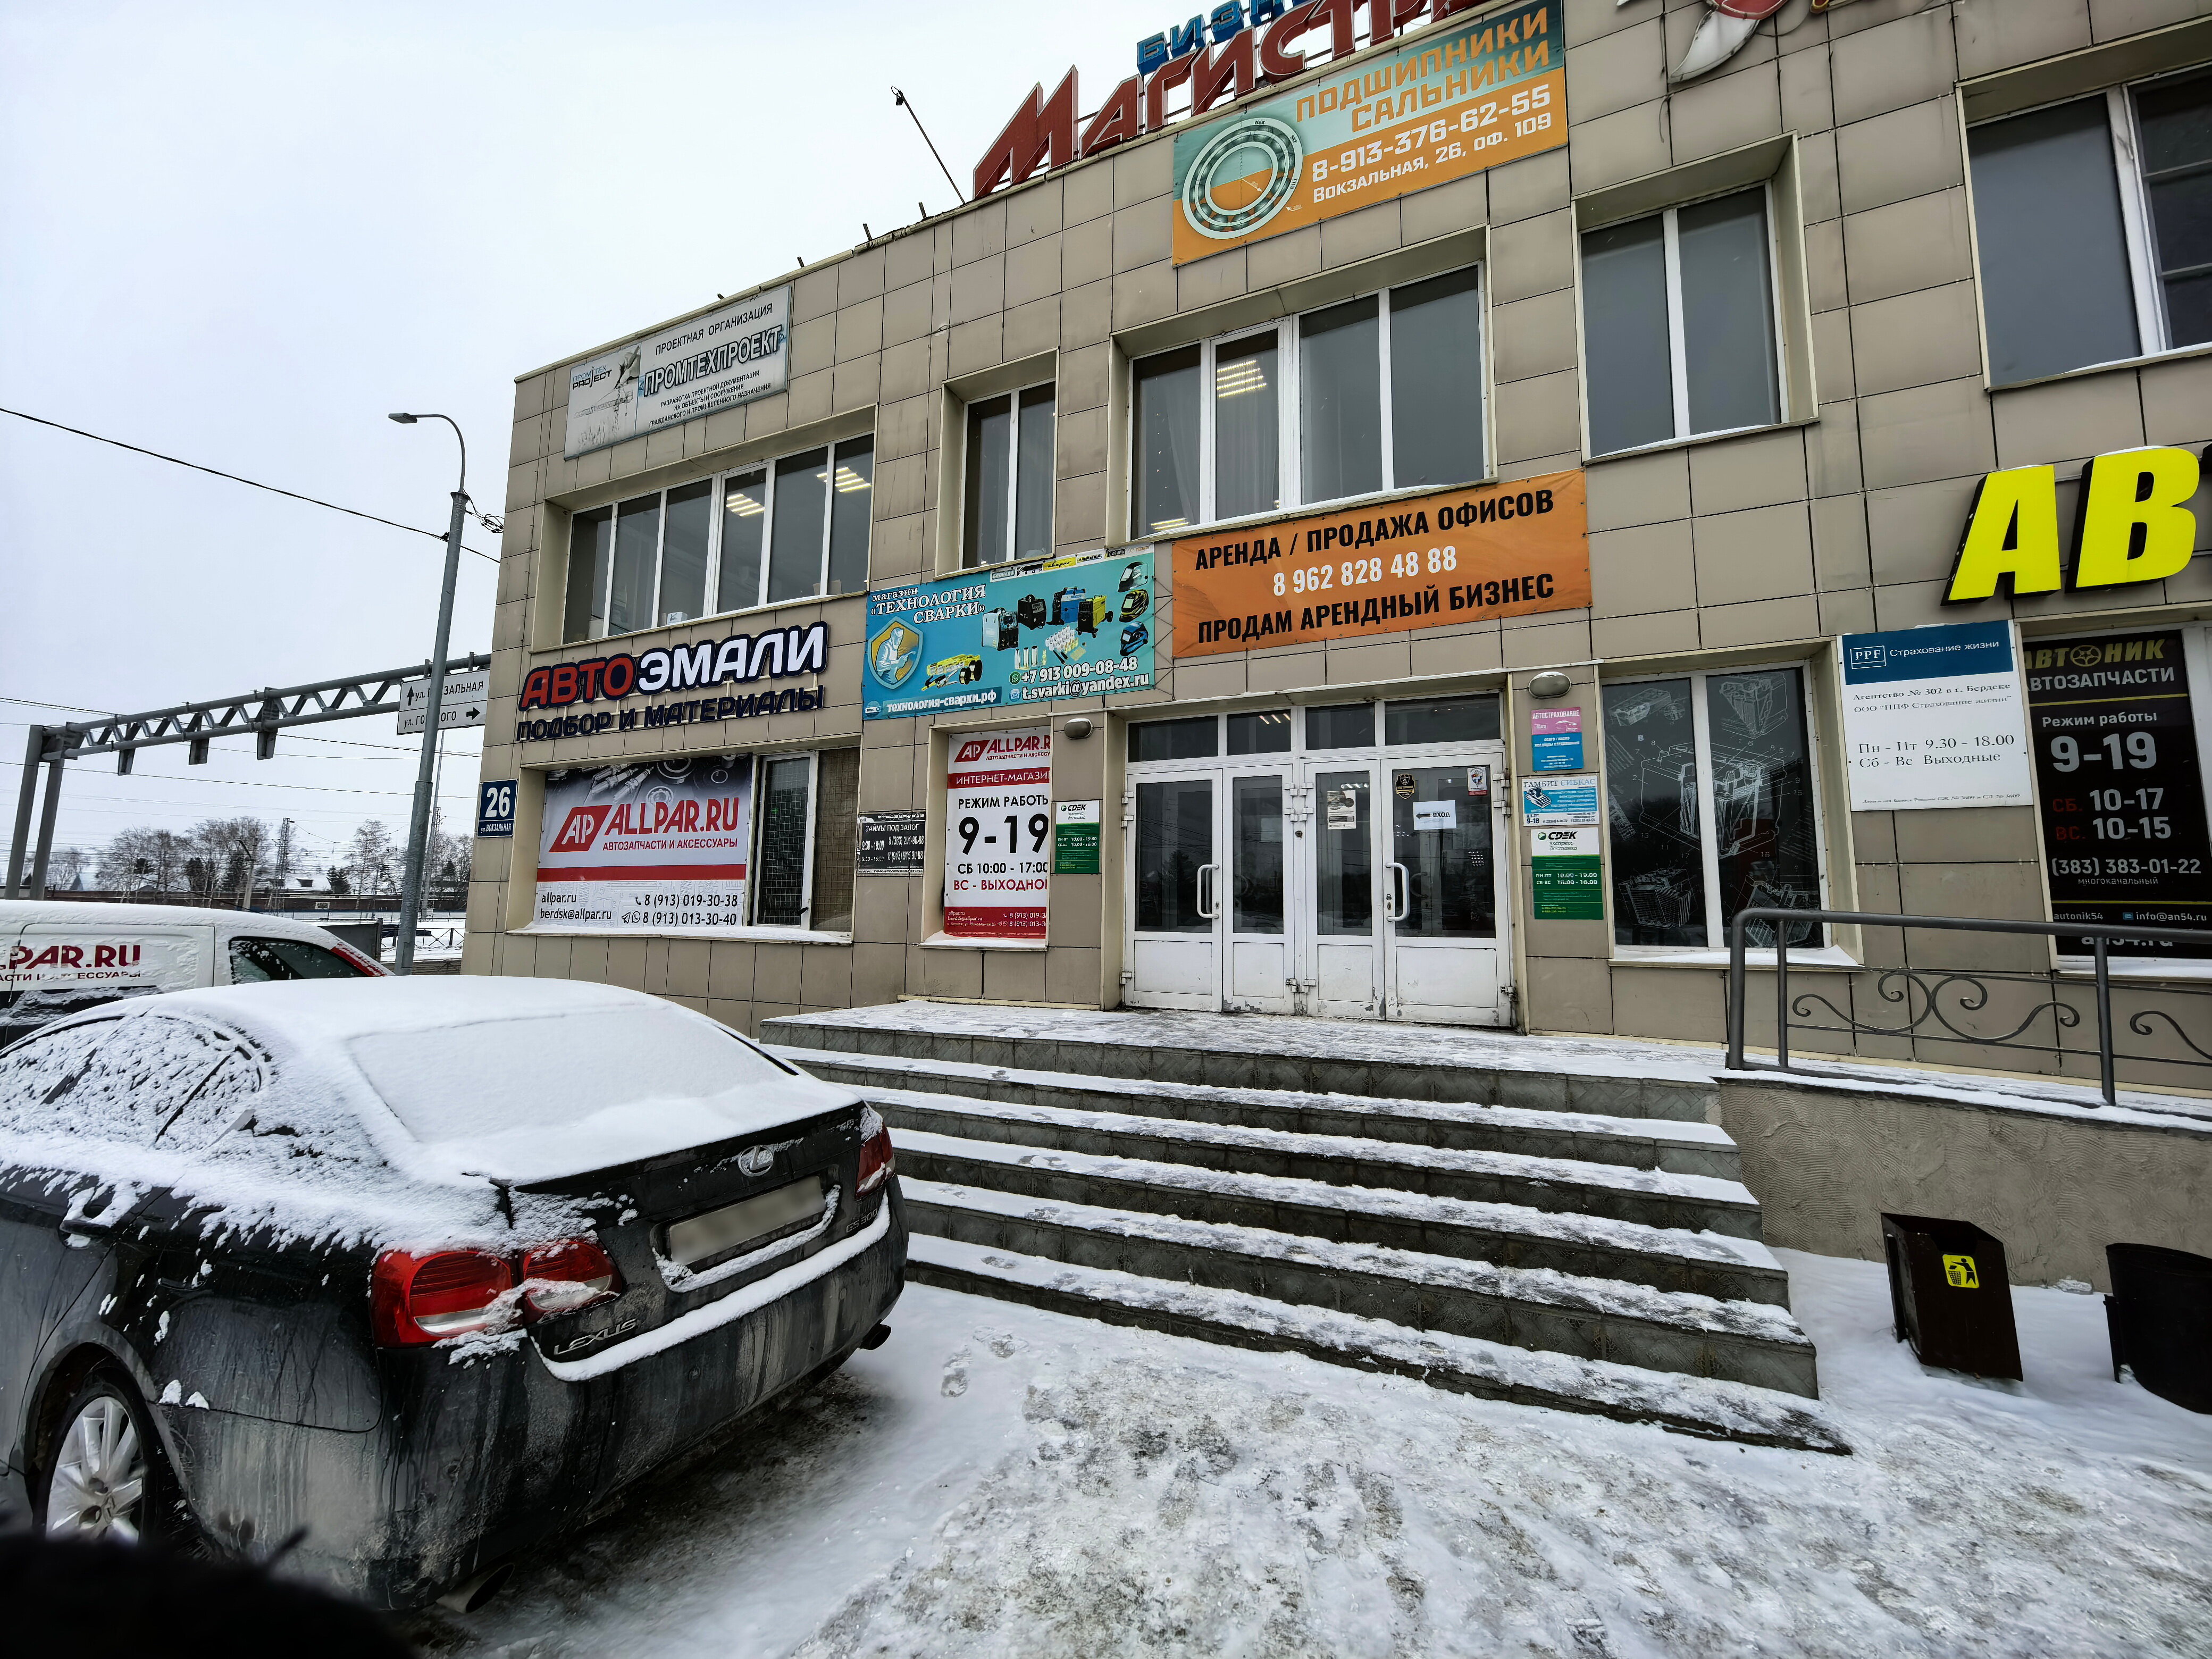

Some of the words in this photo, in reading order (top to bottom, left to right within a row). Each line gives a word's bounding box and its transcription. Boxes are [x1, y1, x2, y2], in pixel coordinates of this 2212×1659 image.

[1297, 7, 1547, 123] ПОДШИПНИКИ
[1352, 40, 1549, 132] САЛЬНИКИ
[1312, 84, 1551, 183] 8-913-376-62-55
[1435, 141, 1467, 164] 26,
[1515, 112, 1552, 138] 109
[656, 328, 704, 356] ПРОЕКТНАЯ
[708, 303, 773, 336] ОРГАНИЗАЦИЯ
[660, 393, 691, 408] РАЗРАБОТКА
[691, 382, 719, 398] ПРОЕКТНОЙ
[720, 370, 760, 389] ДОКУМЕНТАЦИИ
[681, 397, 705, 409] ОБЪЕКТЫ
[710, 383, 744, 400] СООРУЖЕНИЯ
[649, 410, 686, 428] ГРАЖДАНСКОГО
[691, 395, 737, 415] ПРОМЫШЛЕННОГО
[738, 383, 772, 399] НАЗНАЧЕНИЯ
[1196, 538, 1281, 571] АРЕНДА
[1289, 533, 1298, 556] /
[1307, 510, 1429, 552] ПРОДАЖА
[1437, 489, 1554, 531] ОФИСОВ
[1941, 446, 2212, 606] АВ
[1273, 572, 1285, 597] 8
[1293, 564, 1333, 594] 962
[1341, 557, 1382, 587] 828
[1391, 551, 1419, 579] 48
[1428, 545, 1457, 574] 88
[870, 584, 986, 616] «ТЕХНОЛОГИЯ
[872, 586, 919, 602] магазин
[913, 600, 986, 625] СВАРКИ»
[1198, 611, 1293, 644] ПРОДАМ
[1300, 583, 1440, 631] АРЕНДНЫЙ
[1449, 573, 1554, 611] БИЗНЕС
[1855, 649, 1881, 660] PPF
[1890, 644, 1962, 657] Страхование
[520, 622, 827, 710] АВТОЭМАЛИ
[1021, 669, 1037, 685] +7
[1039, 666, 1061, 683] 913
[1062, 656, 1138, 680] 009-08-48
[415, 692, 425, 701] ул.
[427, 681, 483, 698] ЗАЛЬНАЯ
[1021, 673, 1150, 701] t.svarki@yandex.ru
[2027, 667, 2175, 691] ВТОЗАПЧАСТИ
[517, 711, 613, 742] ПОДБОР
[618, 708, 636, 731] И
[643, 685, 824, 727] МАТЕРИАЛЫ
[886, 689, 997, 714] технология-сварки.рф
[404, 719, 413, 729] ул.
[1532, 710, 1580, 719] АВТОСТРАХОВАНИЕ
[2042, 716, 2094, 727] Режим
[2100, 711, 2157, 726] работы
[986, 735, 1050, 754] ALLPAR.R
[1858, 743, 1880, 754] Пн
[1897, 741, 1917, 751] Пт
[1925, 738, 1956, 750] 9.30
[1974, 734, 2015, 747] 18.00
[2051, 732, 2157, 773] 9-19
[1859, 757, 1879, 768] Сб
[1896, 756, 1913, 766] Вс
[1924, 753, 2001, 766] Выходные
[956, 771, 1050, 785] ИНТЕРНЕТ-МАГАЗИ
[485, 786, 510, 818] 26
[958, 797, 1000, 809] РЕЖИМ
[2052, 798, 2083, 812] СБ.
[2089, 788, 2164, 812] 10-17
[486, 823, 512, 832] ВОКЗАЛЬНАЯ
[604, 797, 739, 835] ALLPAR.RU
[865, 824, 886, 832] ЗАЙМЫ
[2055, 826, 2086, 841] ВС.
[2092, 816, 2171, 840] 10-15
[602, 840, 667, 851] АВТОЗАПЧАСТИ
[669, 840, 675, 849] И
[676, 838, 738, 848] АКСЕССУАРЫ
[958, 863, 973, 874] СБ
[977, 862, 1007, 874] 10:00
[2051, 857, 2100, 876] (383)
[2106, 858, 2201, 875] 383-01-22
[953, 880, 969, 891] ВС
[981, 878, 1048, 891] ВЫХОДНО
[2078, 876, 2158, 886] многоканальный
[541, 892, 576, 908] allpar.ru
[644, 894, 650, 906] 8
[653, 894, 680, 909] (913)
[683, 894, 738, 907] 019-30-38
[540, 908, 612, 923] berdsk@allpar.ru
[643, 911, 648, 924] 8
[652, 911, 678, 927] (913)
[681, 911, 737, 926] 013-30-40
[2054, 911, 2104, 920] autonik54
[2136, 911, 2207, 921] info@an54.ru
[0, 945, 141, 969] PAR.RU
[860, 1208, 878, 1225] 300
[554, 1318, 637, 1355] LEXUS
